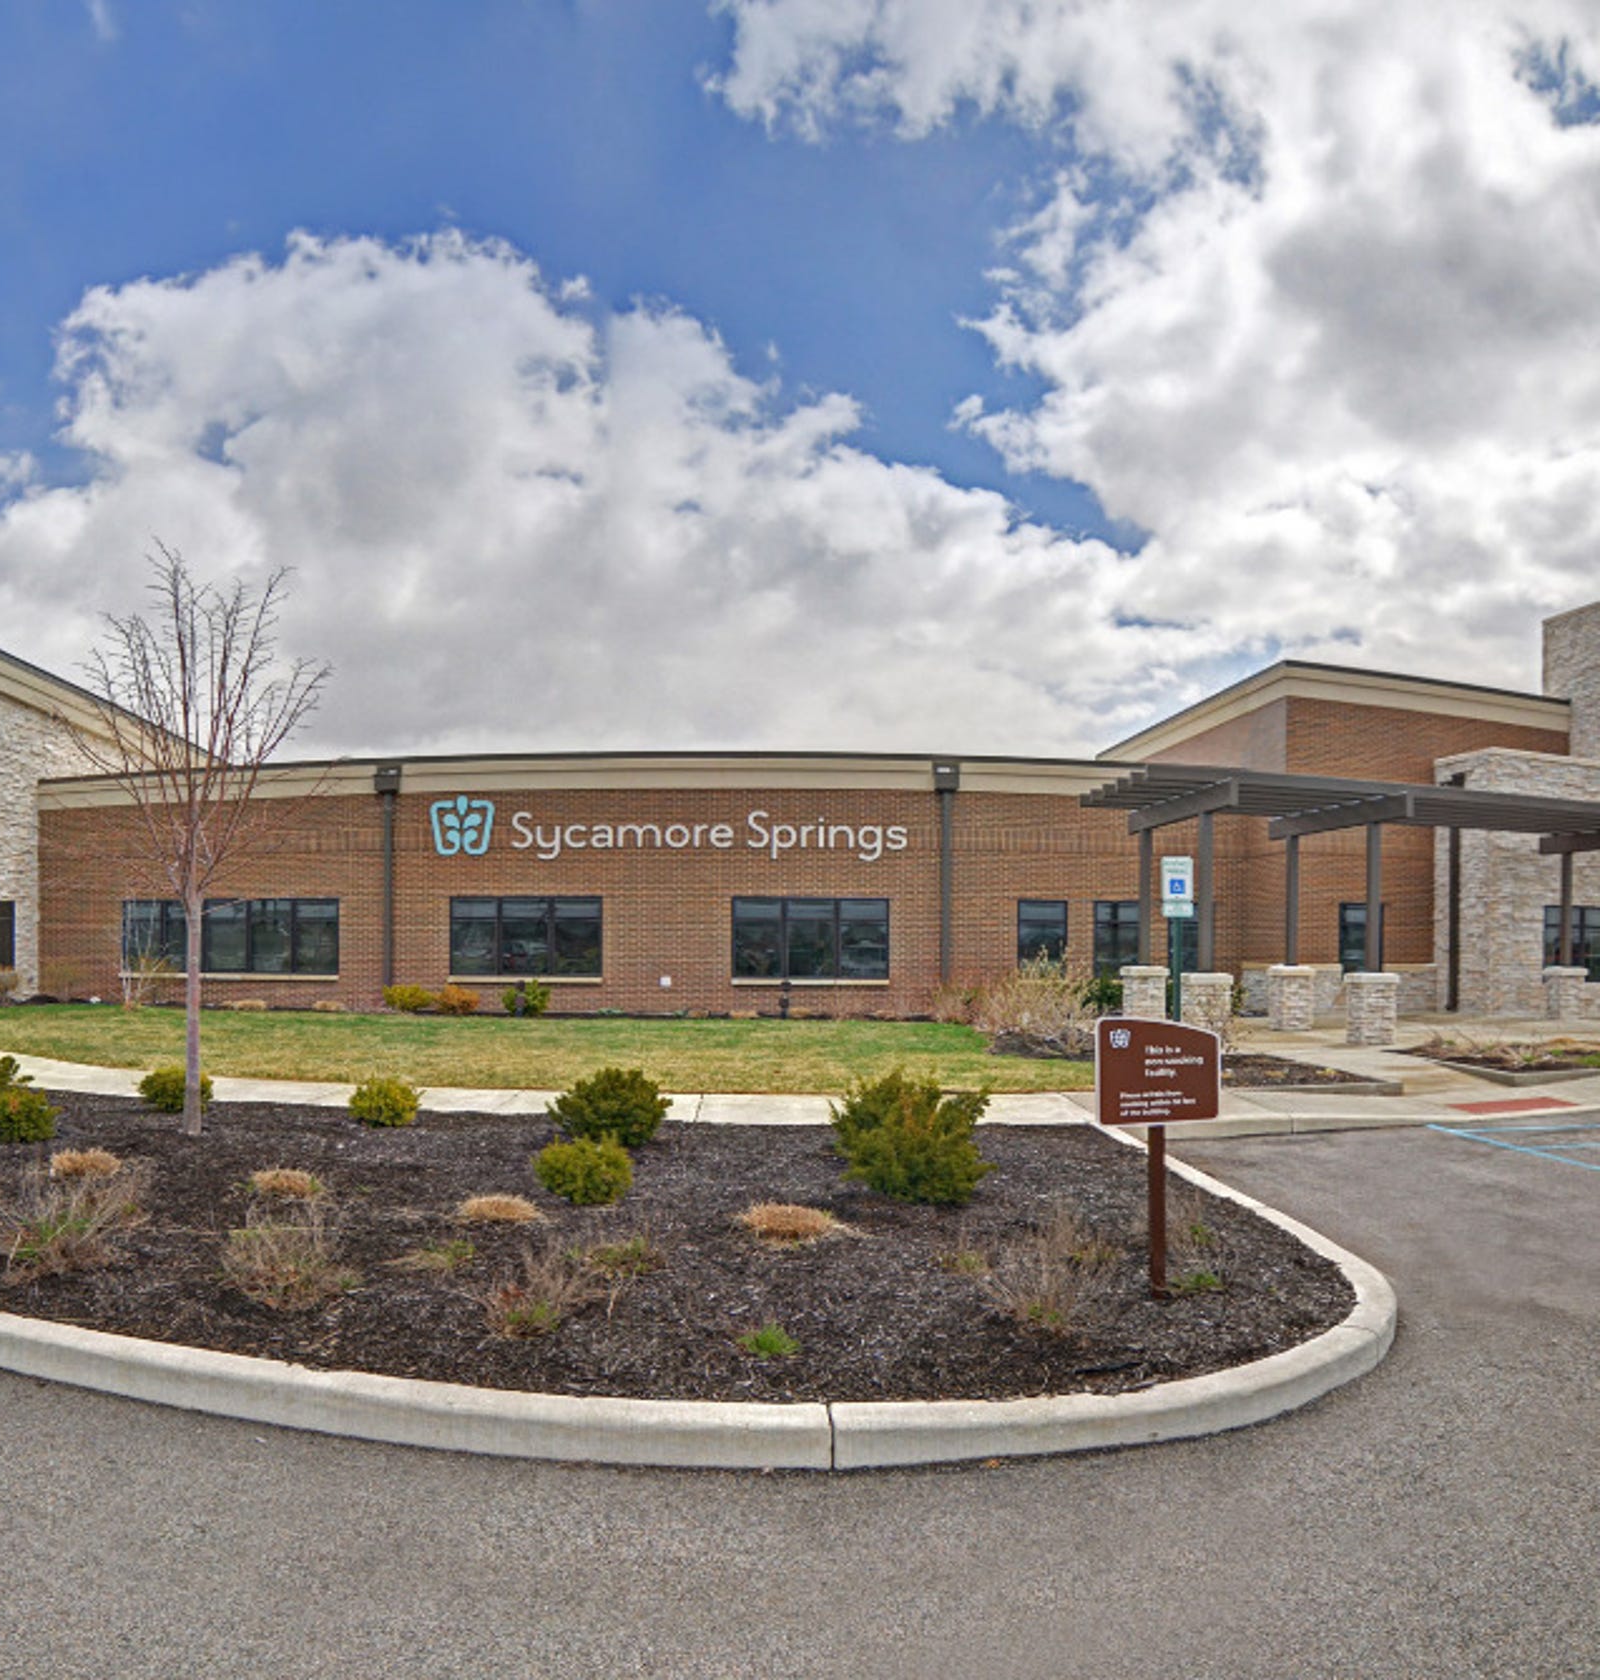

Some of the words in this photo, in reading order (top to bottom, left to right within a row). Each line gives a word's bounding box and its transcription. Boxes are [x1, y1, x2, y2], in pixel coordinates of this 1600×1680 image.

[511, 811, 734, 860] Sycamore
[747, 810, 908, 861] Springs
[1145, 1045, 1163, 1054] This
